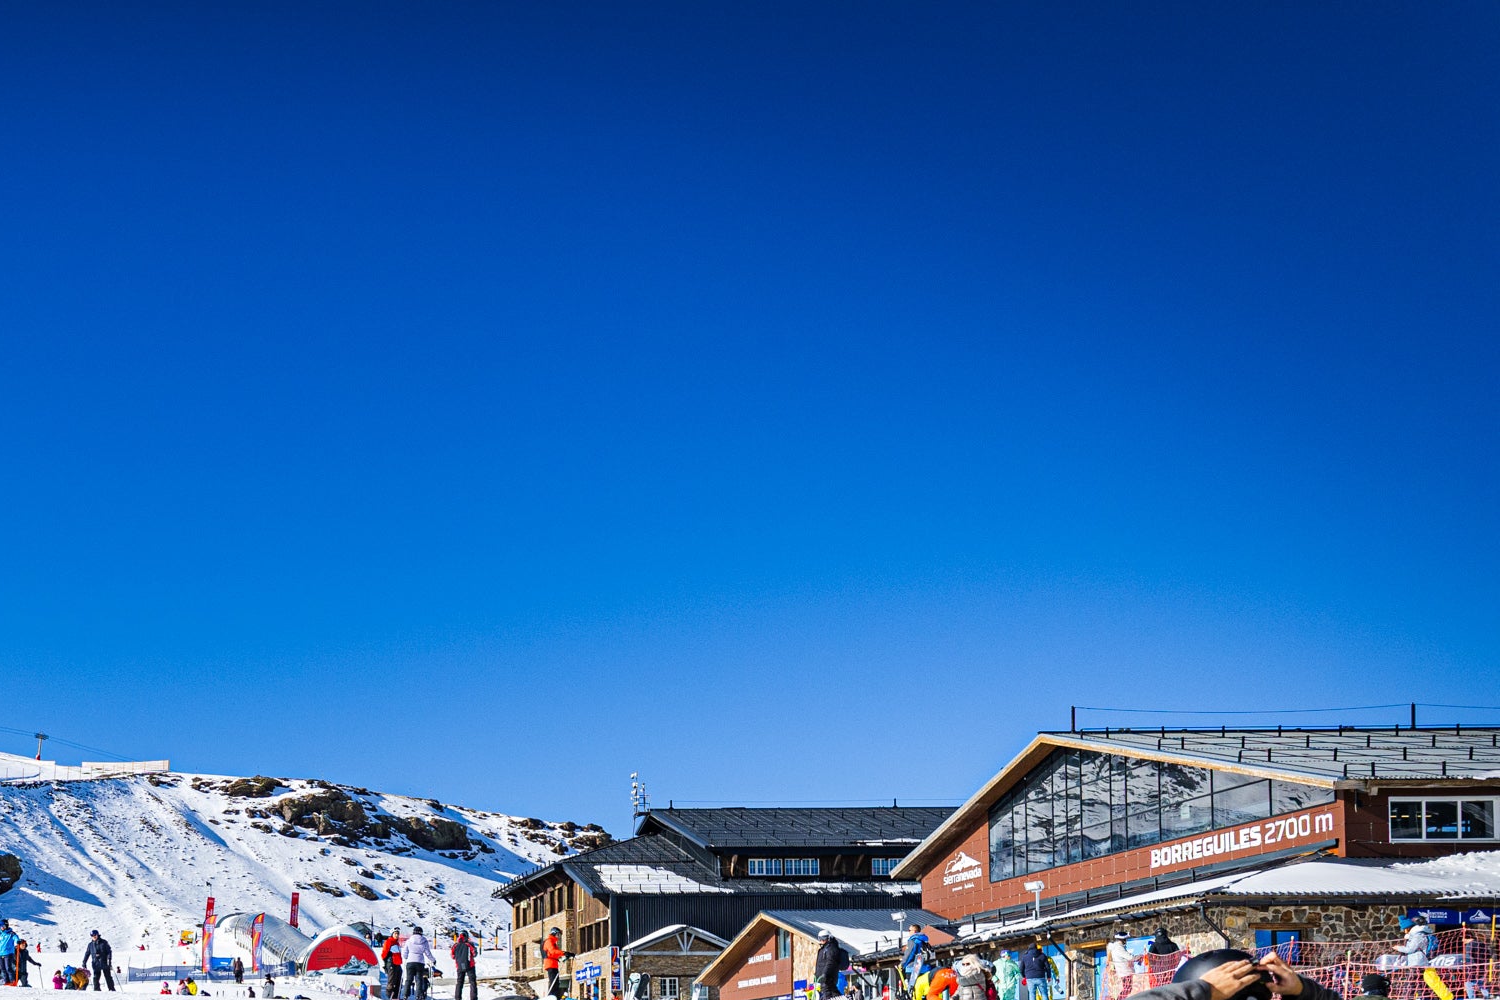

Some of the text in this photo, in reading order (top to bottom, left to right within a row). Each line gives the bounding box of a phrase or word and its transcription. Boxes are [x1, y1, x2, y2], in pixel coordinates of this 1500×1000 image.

[1150, 813, 1333, 868] BORREGUILES 2700 m
[943, 867, 982, 886] sierranevada
